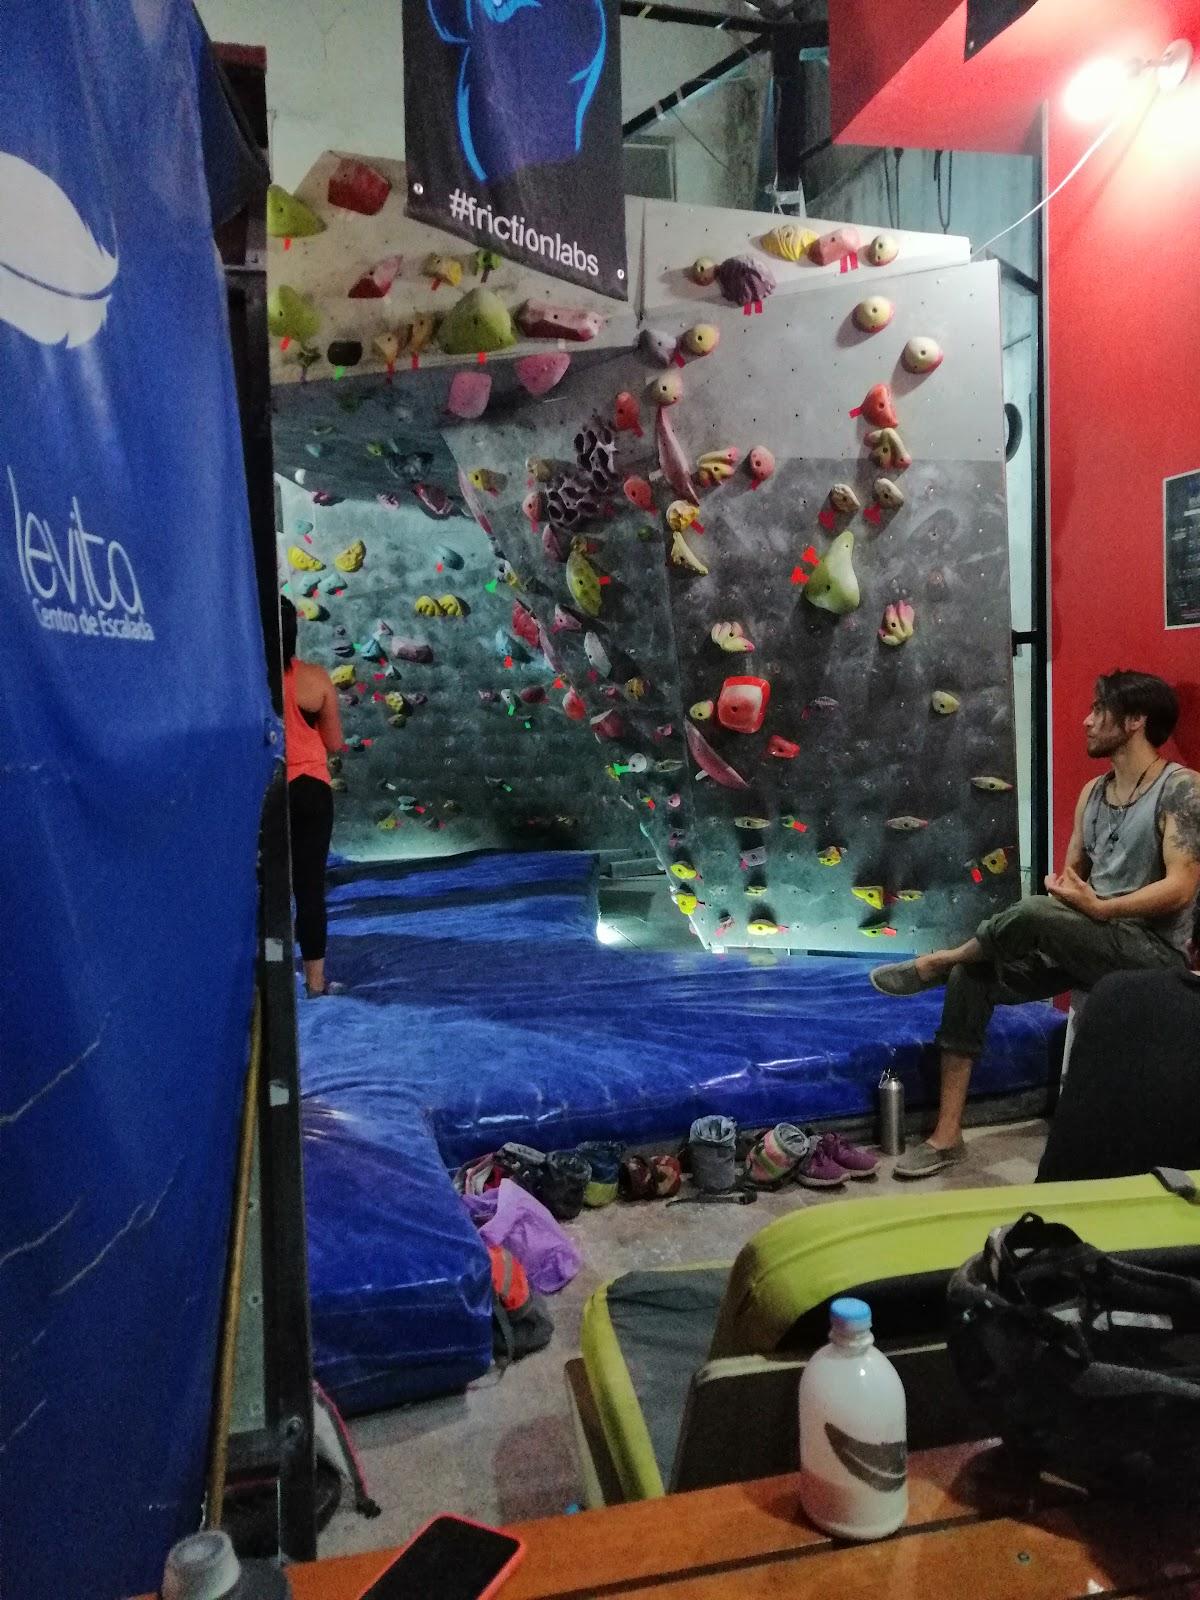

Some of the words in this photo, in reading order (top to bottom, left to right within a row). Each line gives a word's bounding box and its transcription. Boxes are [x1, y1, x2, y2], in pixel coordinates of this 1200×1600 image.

[449, 188, 599, 276] #frictionlabs
[7, 465, 145, 615] levita
[32, 598, 79, 634] Centro
[79, 607, 101, 636] de
